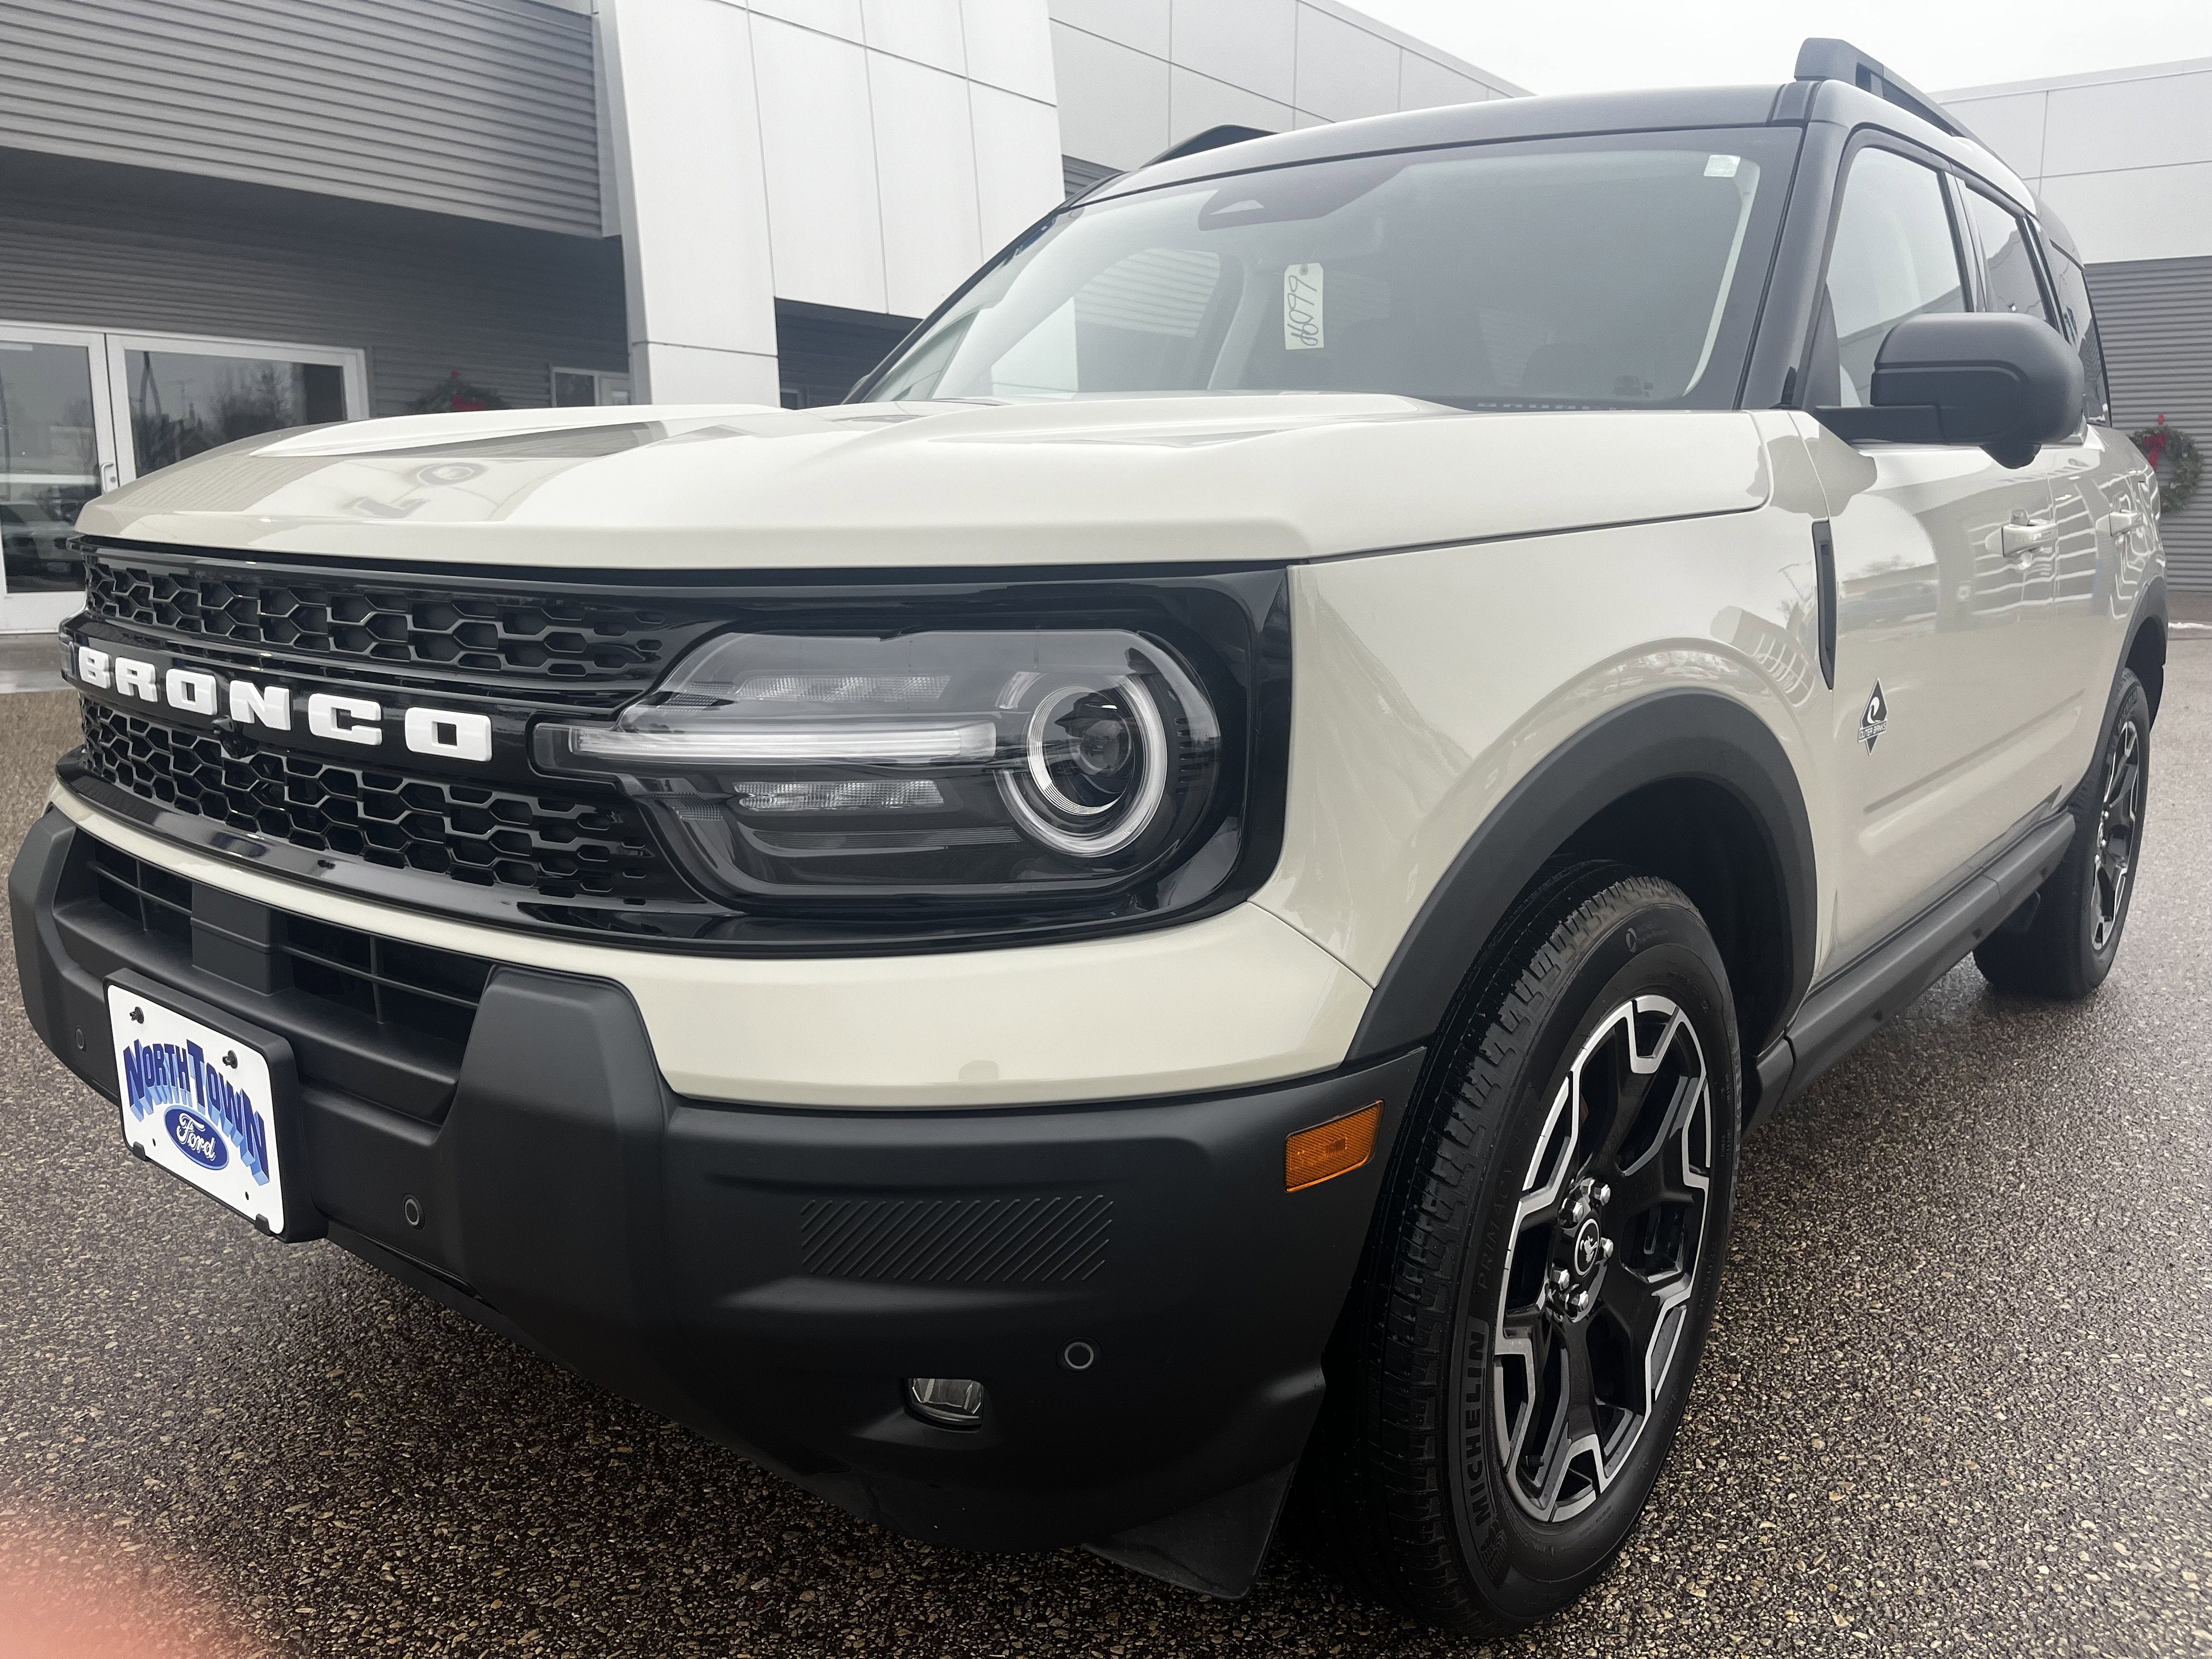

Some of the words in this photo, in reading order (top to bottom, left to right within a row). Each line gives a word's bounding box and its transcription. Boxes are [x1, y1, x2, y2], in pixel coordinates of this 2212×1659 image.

[78, 646, 493, 763] BRONCO
[1859, 727, 1873, 740] OUTER
[176, 1112, 217, 1160] Ford
[1477, 1161, 1514, 1290] PRIMACY
[1465, 1331, 1491, 1527] MICHELIN
